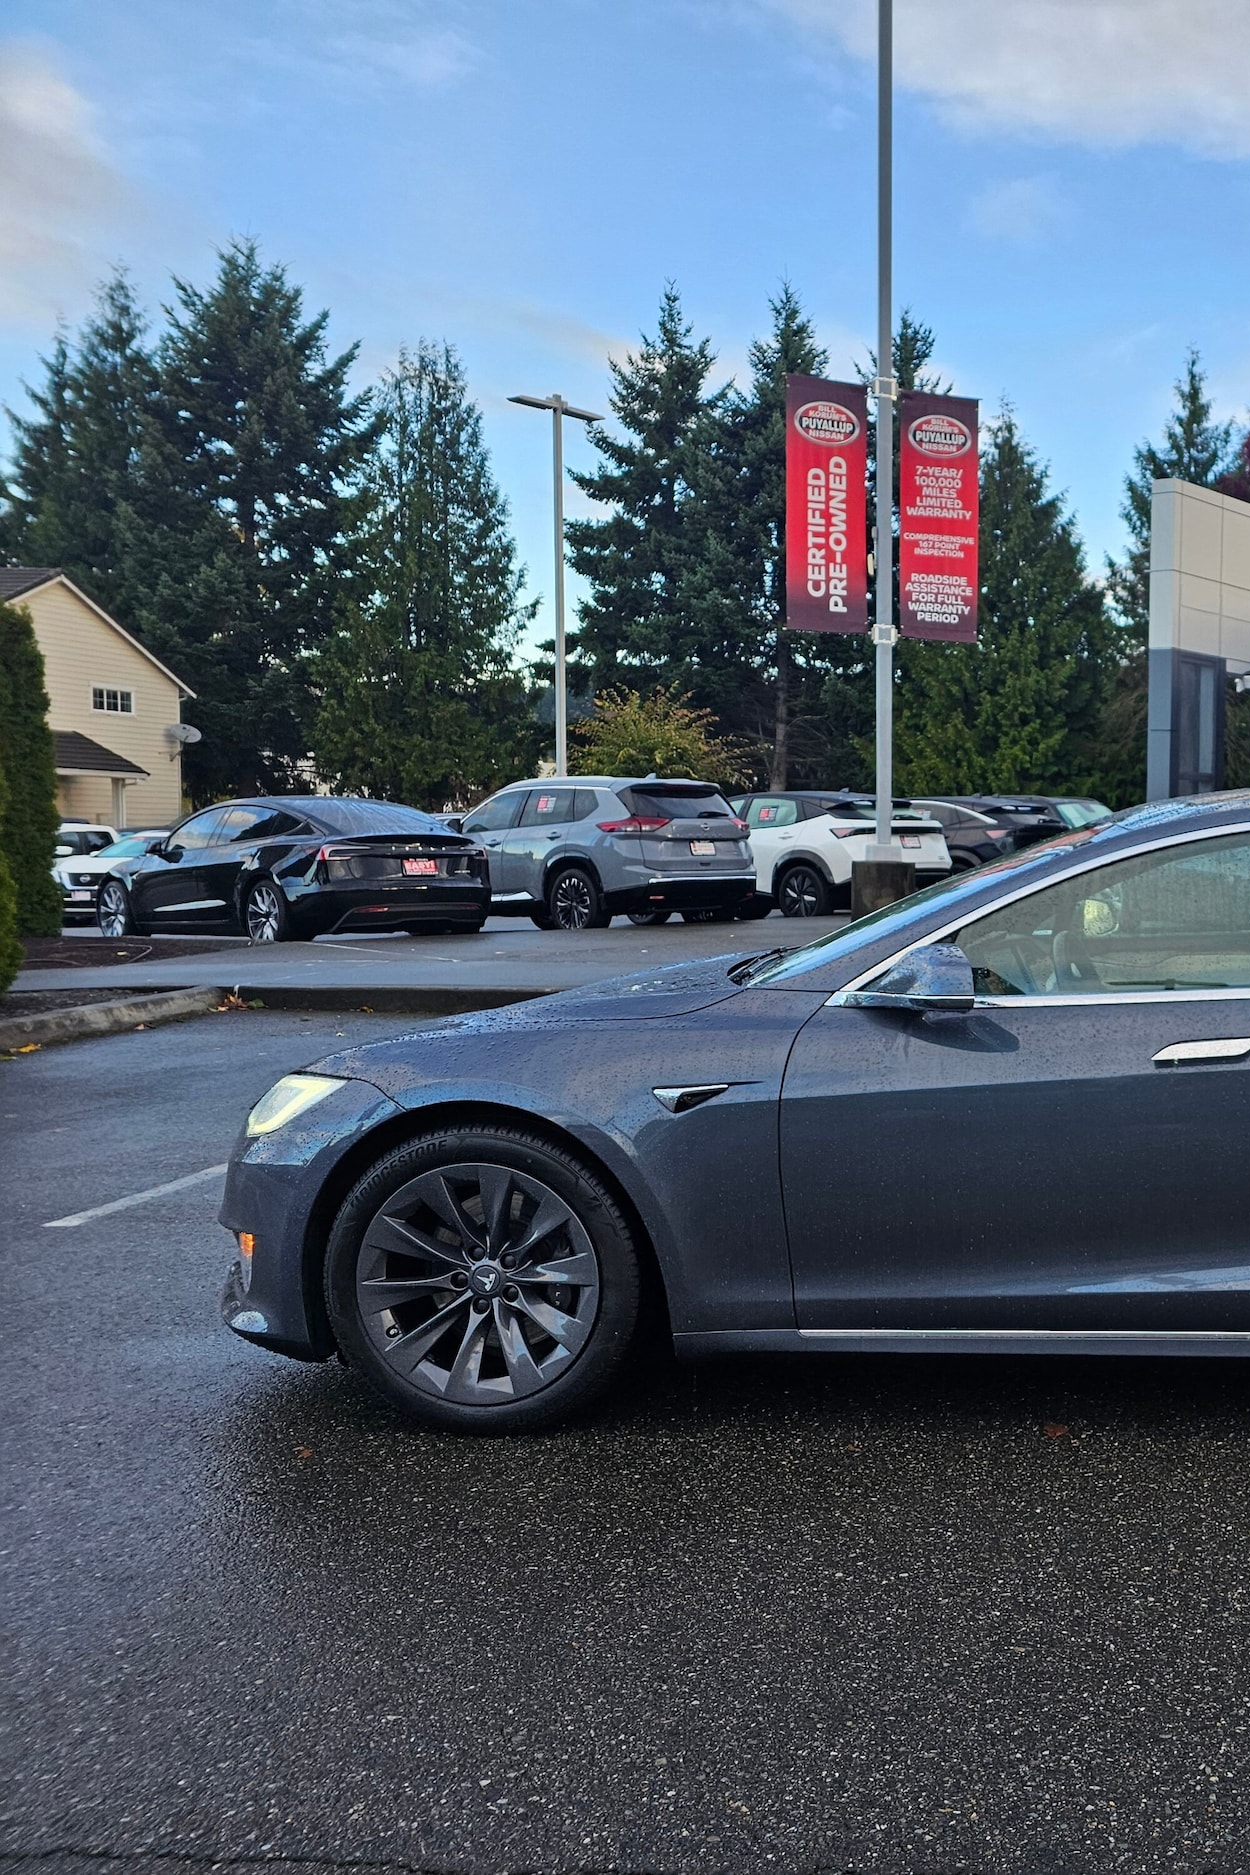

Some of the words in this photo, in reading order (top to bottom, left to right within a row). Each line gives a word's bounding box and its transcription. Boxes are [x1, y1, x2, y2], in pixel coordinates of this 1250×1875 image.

[818, 405, 836, 413] BILL
[801, 416, 854, 434] PUYALLUP
[931, 418, 949, 426] BILL
[808, 429, 844, 440] NISSAN
[915, 430, 966, 445] PUYALLUP
[922, 442, 957, 452] NISSAN
[915, 465, 964, 479] 7-YEAR/
[914, 475, 962, 488] 100,000
[922, 486, 957, 498] MILES
[916, 496, 963, 509] LIMITED
[906, 505, 972, 520] WARRANTY
[807, 467, 826, 598] CERTIFIED
[828, 455, 848, 613] PRE-OWNED
[903, 532, 975, 545] COMPREHENSIVE
[918, 540, 933, 548] 167
[934, 541, 960, 550] POINT
[914, 547, 965, 558] INSPECTION
[911, 573, 968, 586] ROADSIDE
[905, 582, 974, 596] ASSISTANCE
[911, 592, 936, 602] FOR
[937, 594, 964, 605] FULL
[907, 601, 971, 615] WARRANTY
[917, 611, 959, 624] PERIOD
